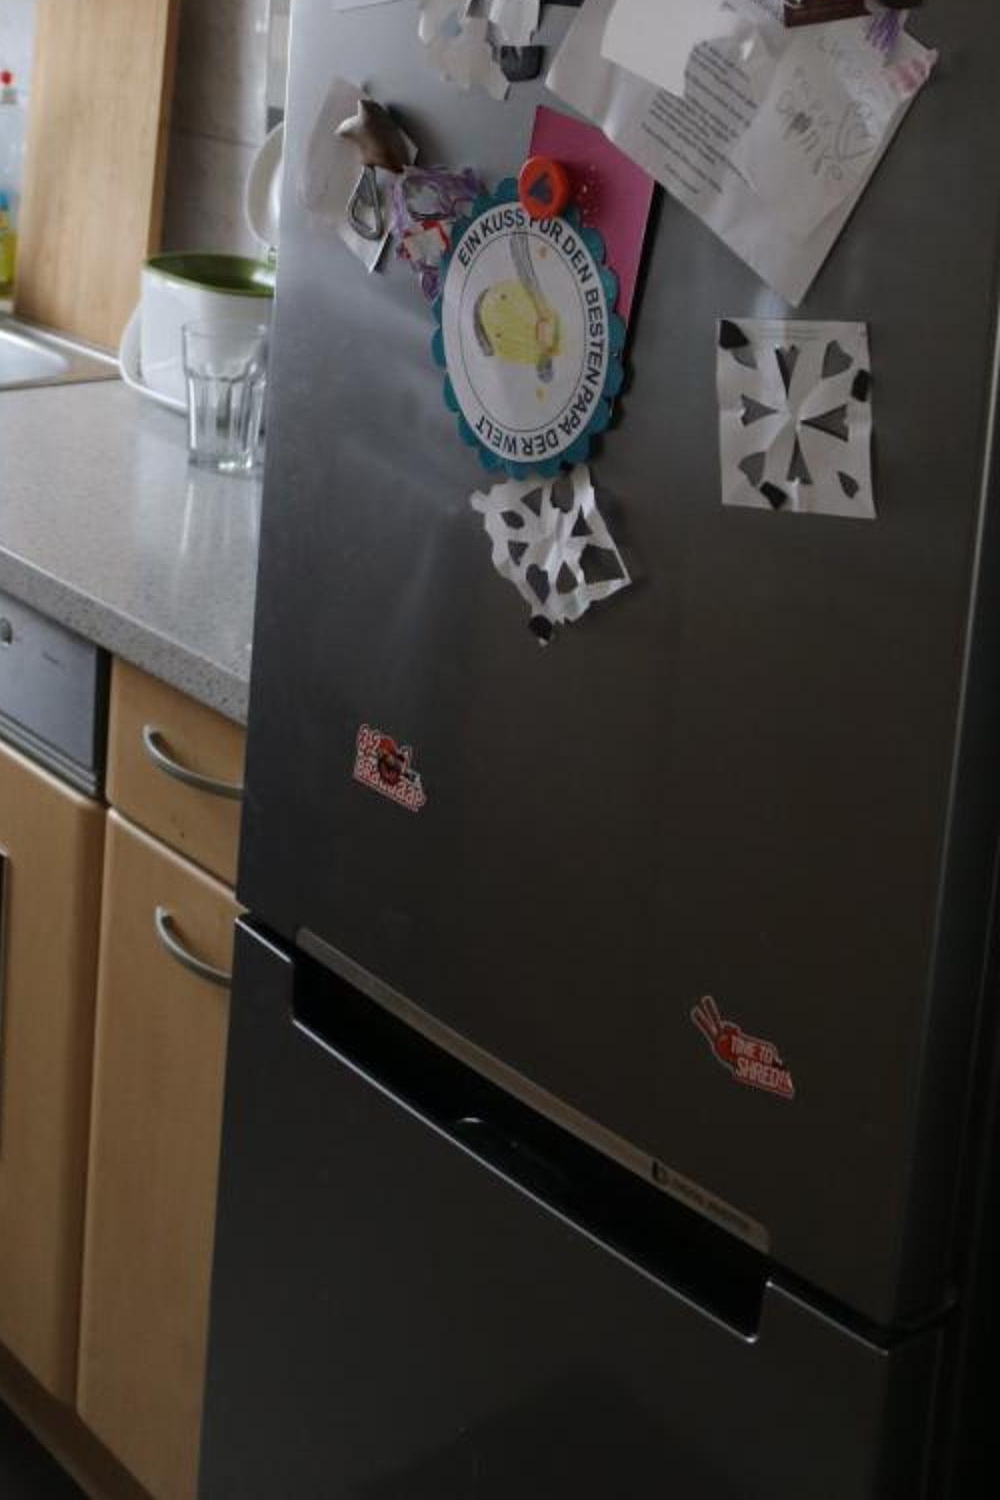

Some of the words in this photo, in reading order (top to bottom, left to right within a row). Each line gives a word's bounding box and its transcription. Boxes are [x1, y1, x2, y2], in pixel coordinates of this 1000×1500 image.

[481, 209, 525, 241] KUSS
[457, 235, 482, 267] EIN
[561, 235, 593, 284] DEN
[584, 287, 606, 386] BESTEN
[558, 384, 595, 436] PAPA
[474, 415, 518, 455] WELT
[522, 434, 559, 456] DER
